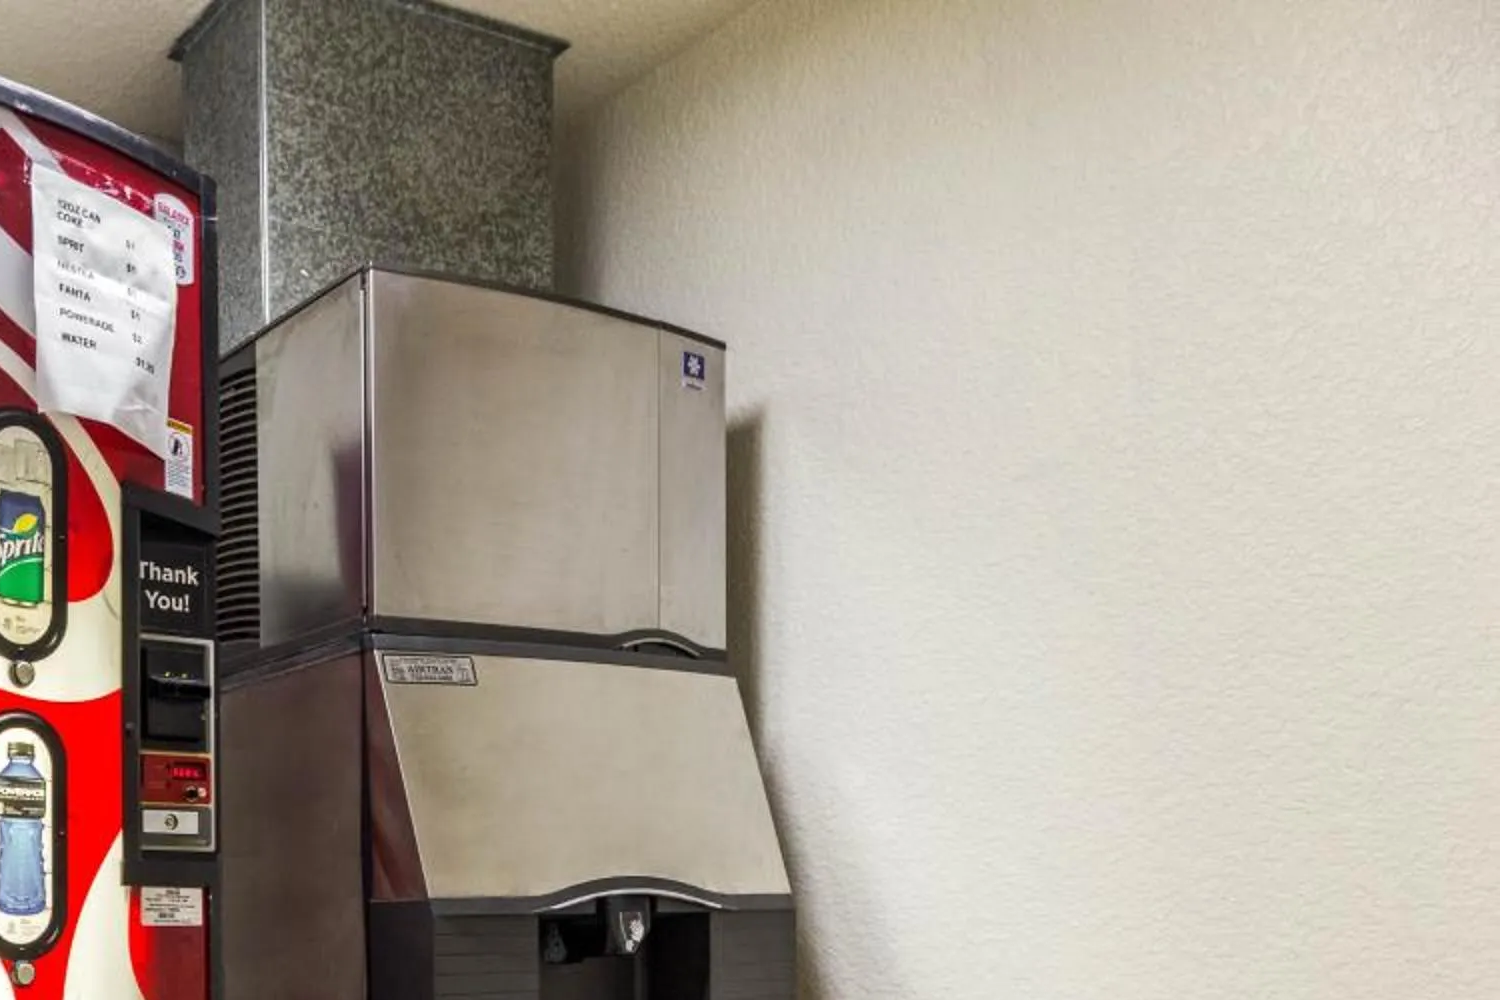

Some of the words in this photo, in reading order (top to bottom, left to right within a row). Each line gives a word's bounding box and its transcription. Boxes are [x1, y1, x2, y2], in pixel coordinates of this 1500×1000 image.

[59, 282, 92, 303] FANTA
[139, 561, 199, 586] Thank
[144, 589, 189, 613] You!
